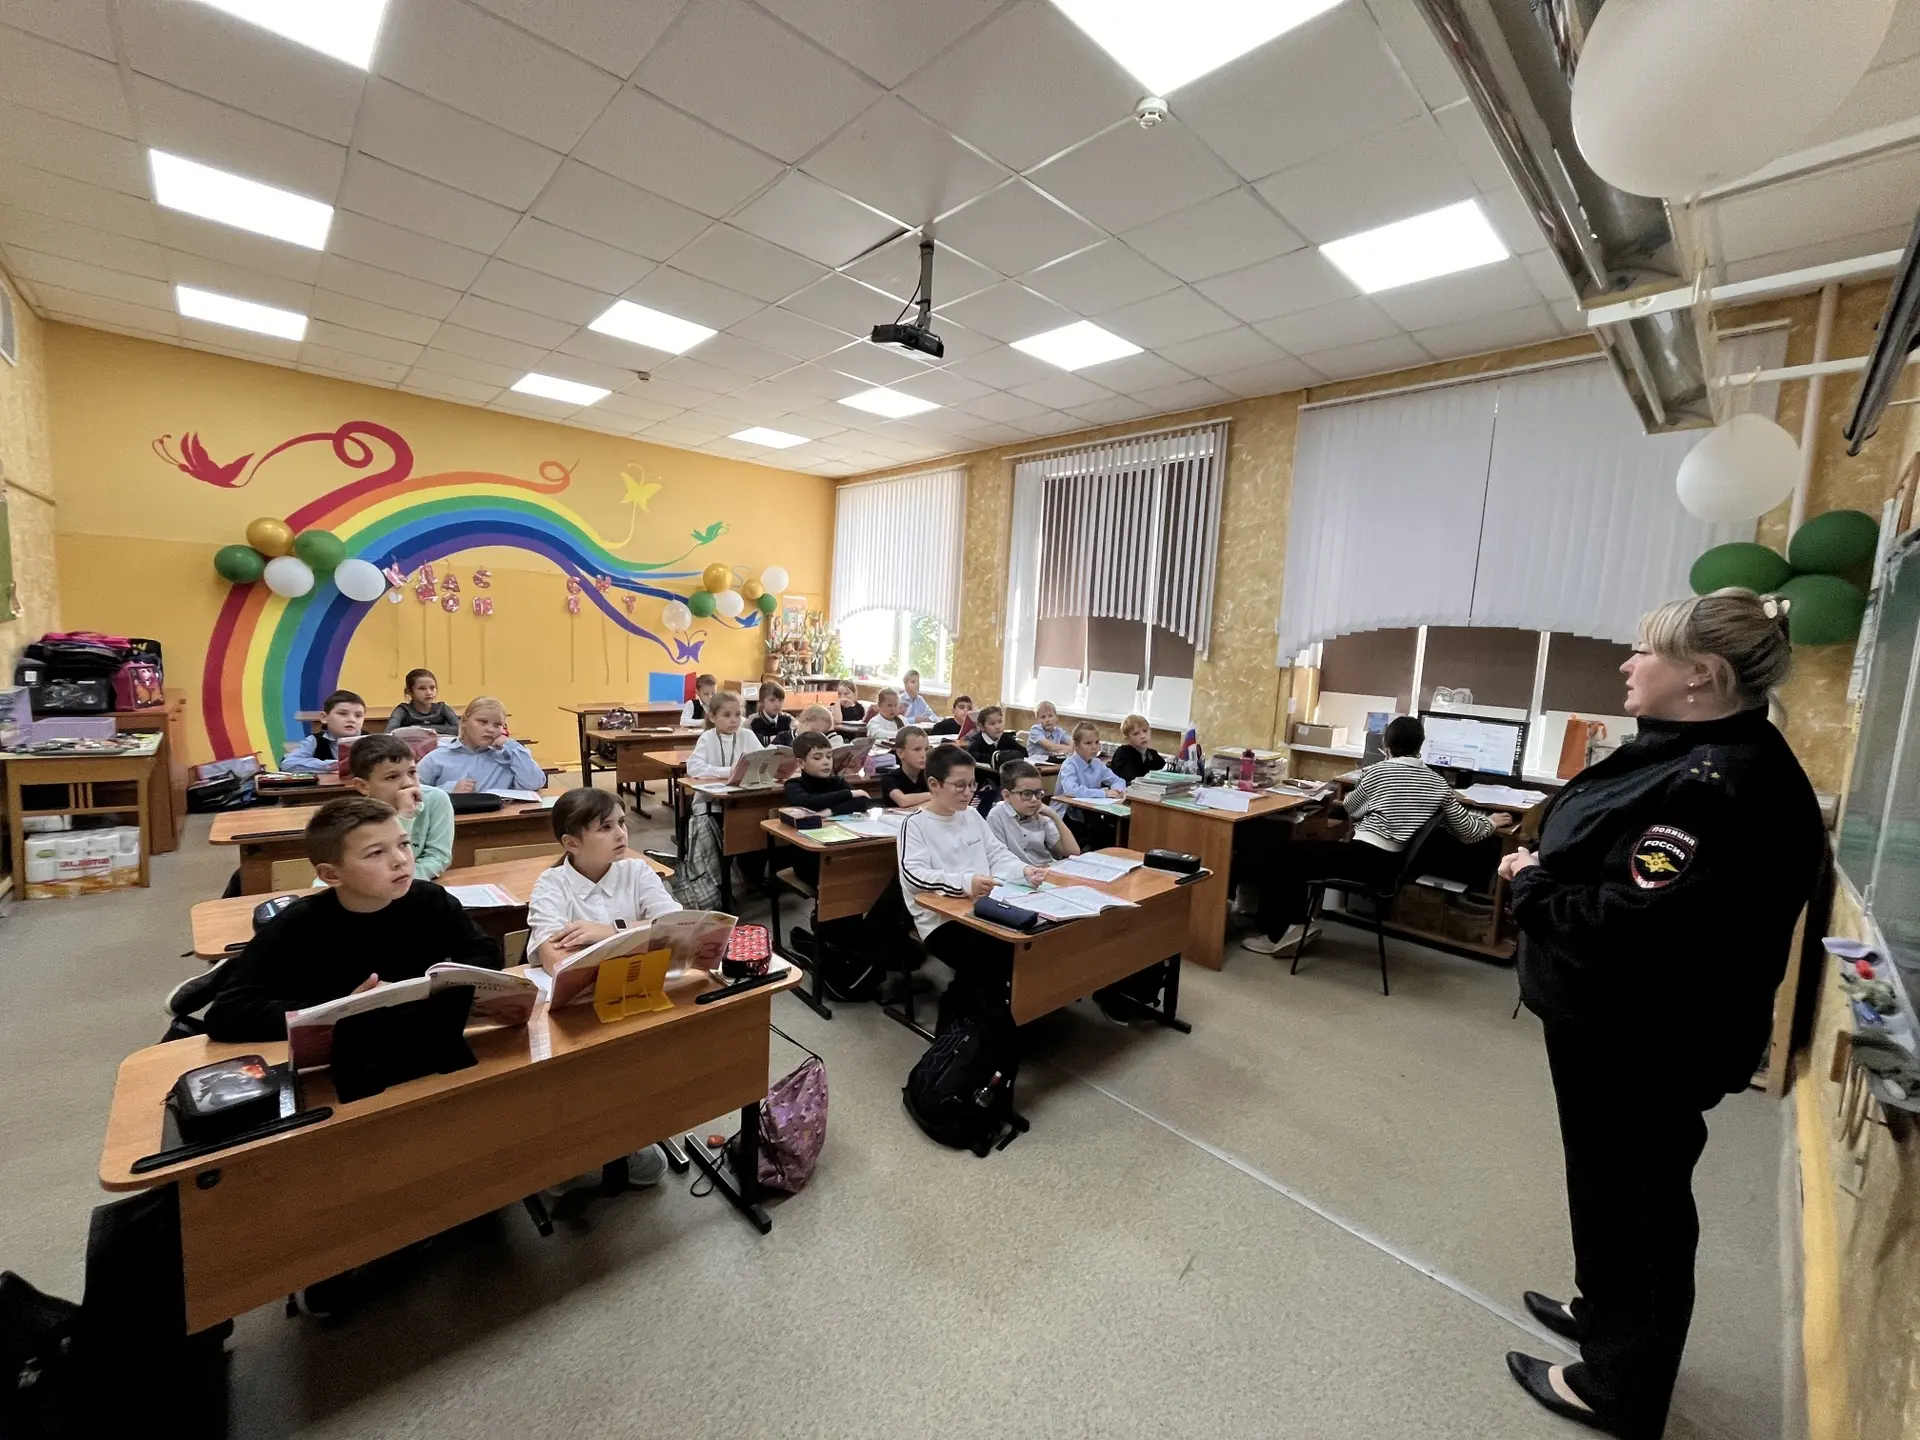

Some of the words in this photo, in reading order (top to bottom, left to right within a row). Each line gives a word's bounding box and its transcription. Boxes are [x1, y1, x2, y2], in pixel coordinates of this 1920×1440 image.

[1651, 826, 1696, 847] ПОЛИЦИЯ
[1643, 840, 1686, 860] РОССИЯ
[1636, 875, 1656, 889] МВД
